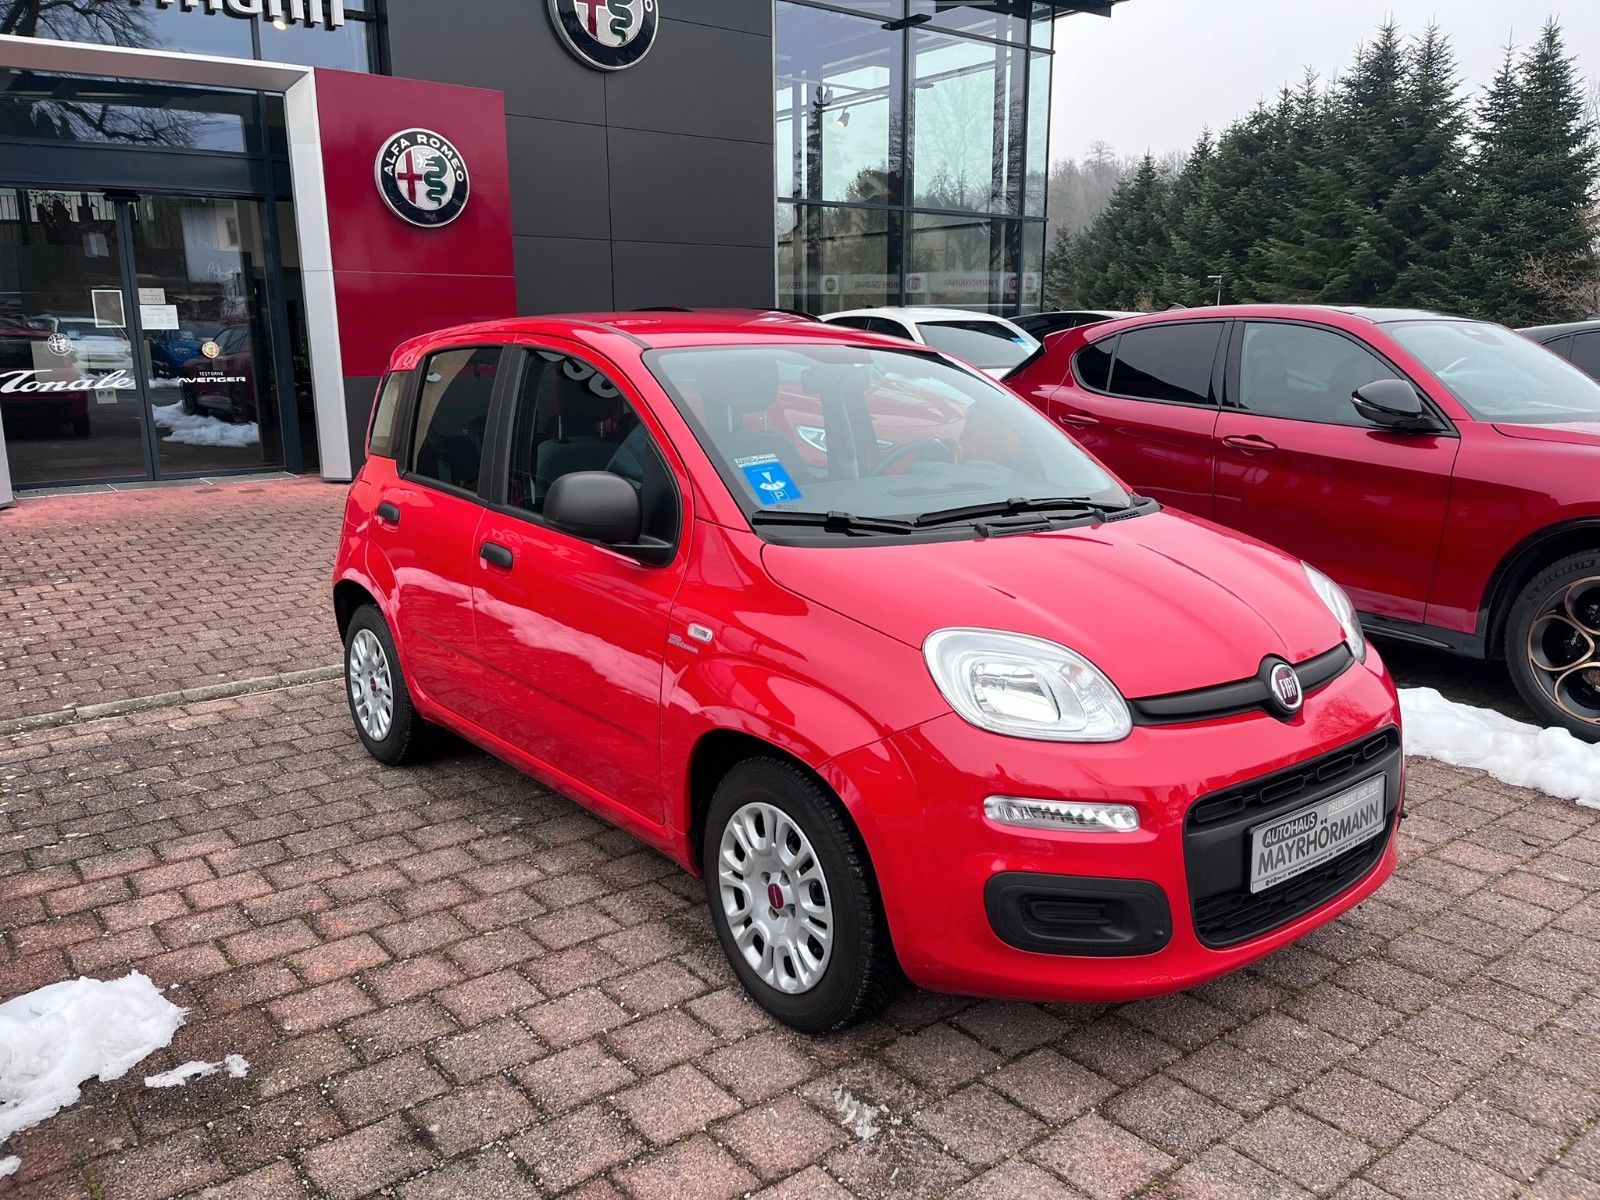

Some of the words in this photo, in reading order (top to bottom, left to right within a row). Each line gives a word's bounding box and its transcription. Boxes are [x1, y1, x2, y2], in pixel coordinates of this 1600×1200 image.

[384, 138, 411, 176] ALFA
[416, 134, 465, 182] ROMEO
[0, 369, 135, 393] Tonale
[1278, 676, 1297, 699] FIAT
[1257, 800, 1379, 876] MAYRHÖRMANN
[1264, 813, 1317, 846] AUTOHAUS
